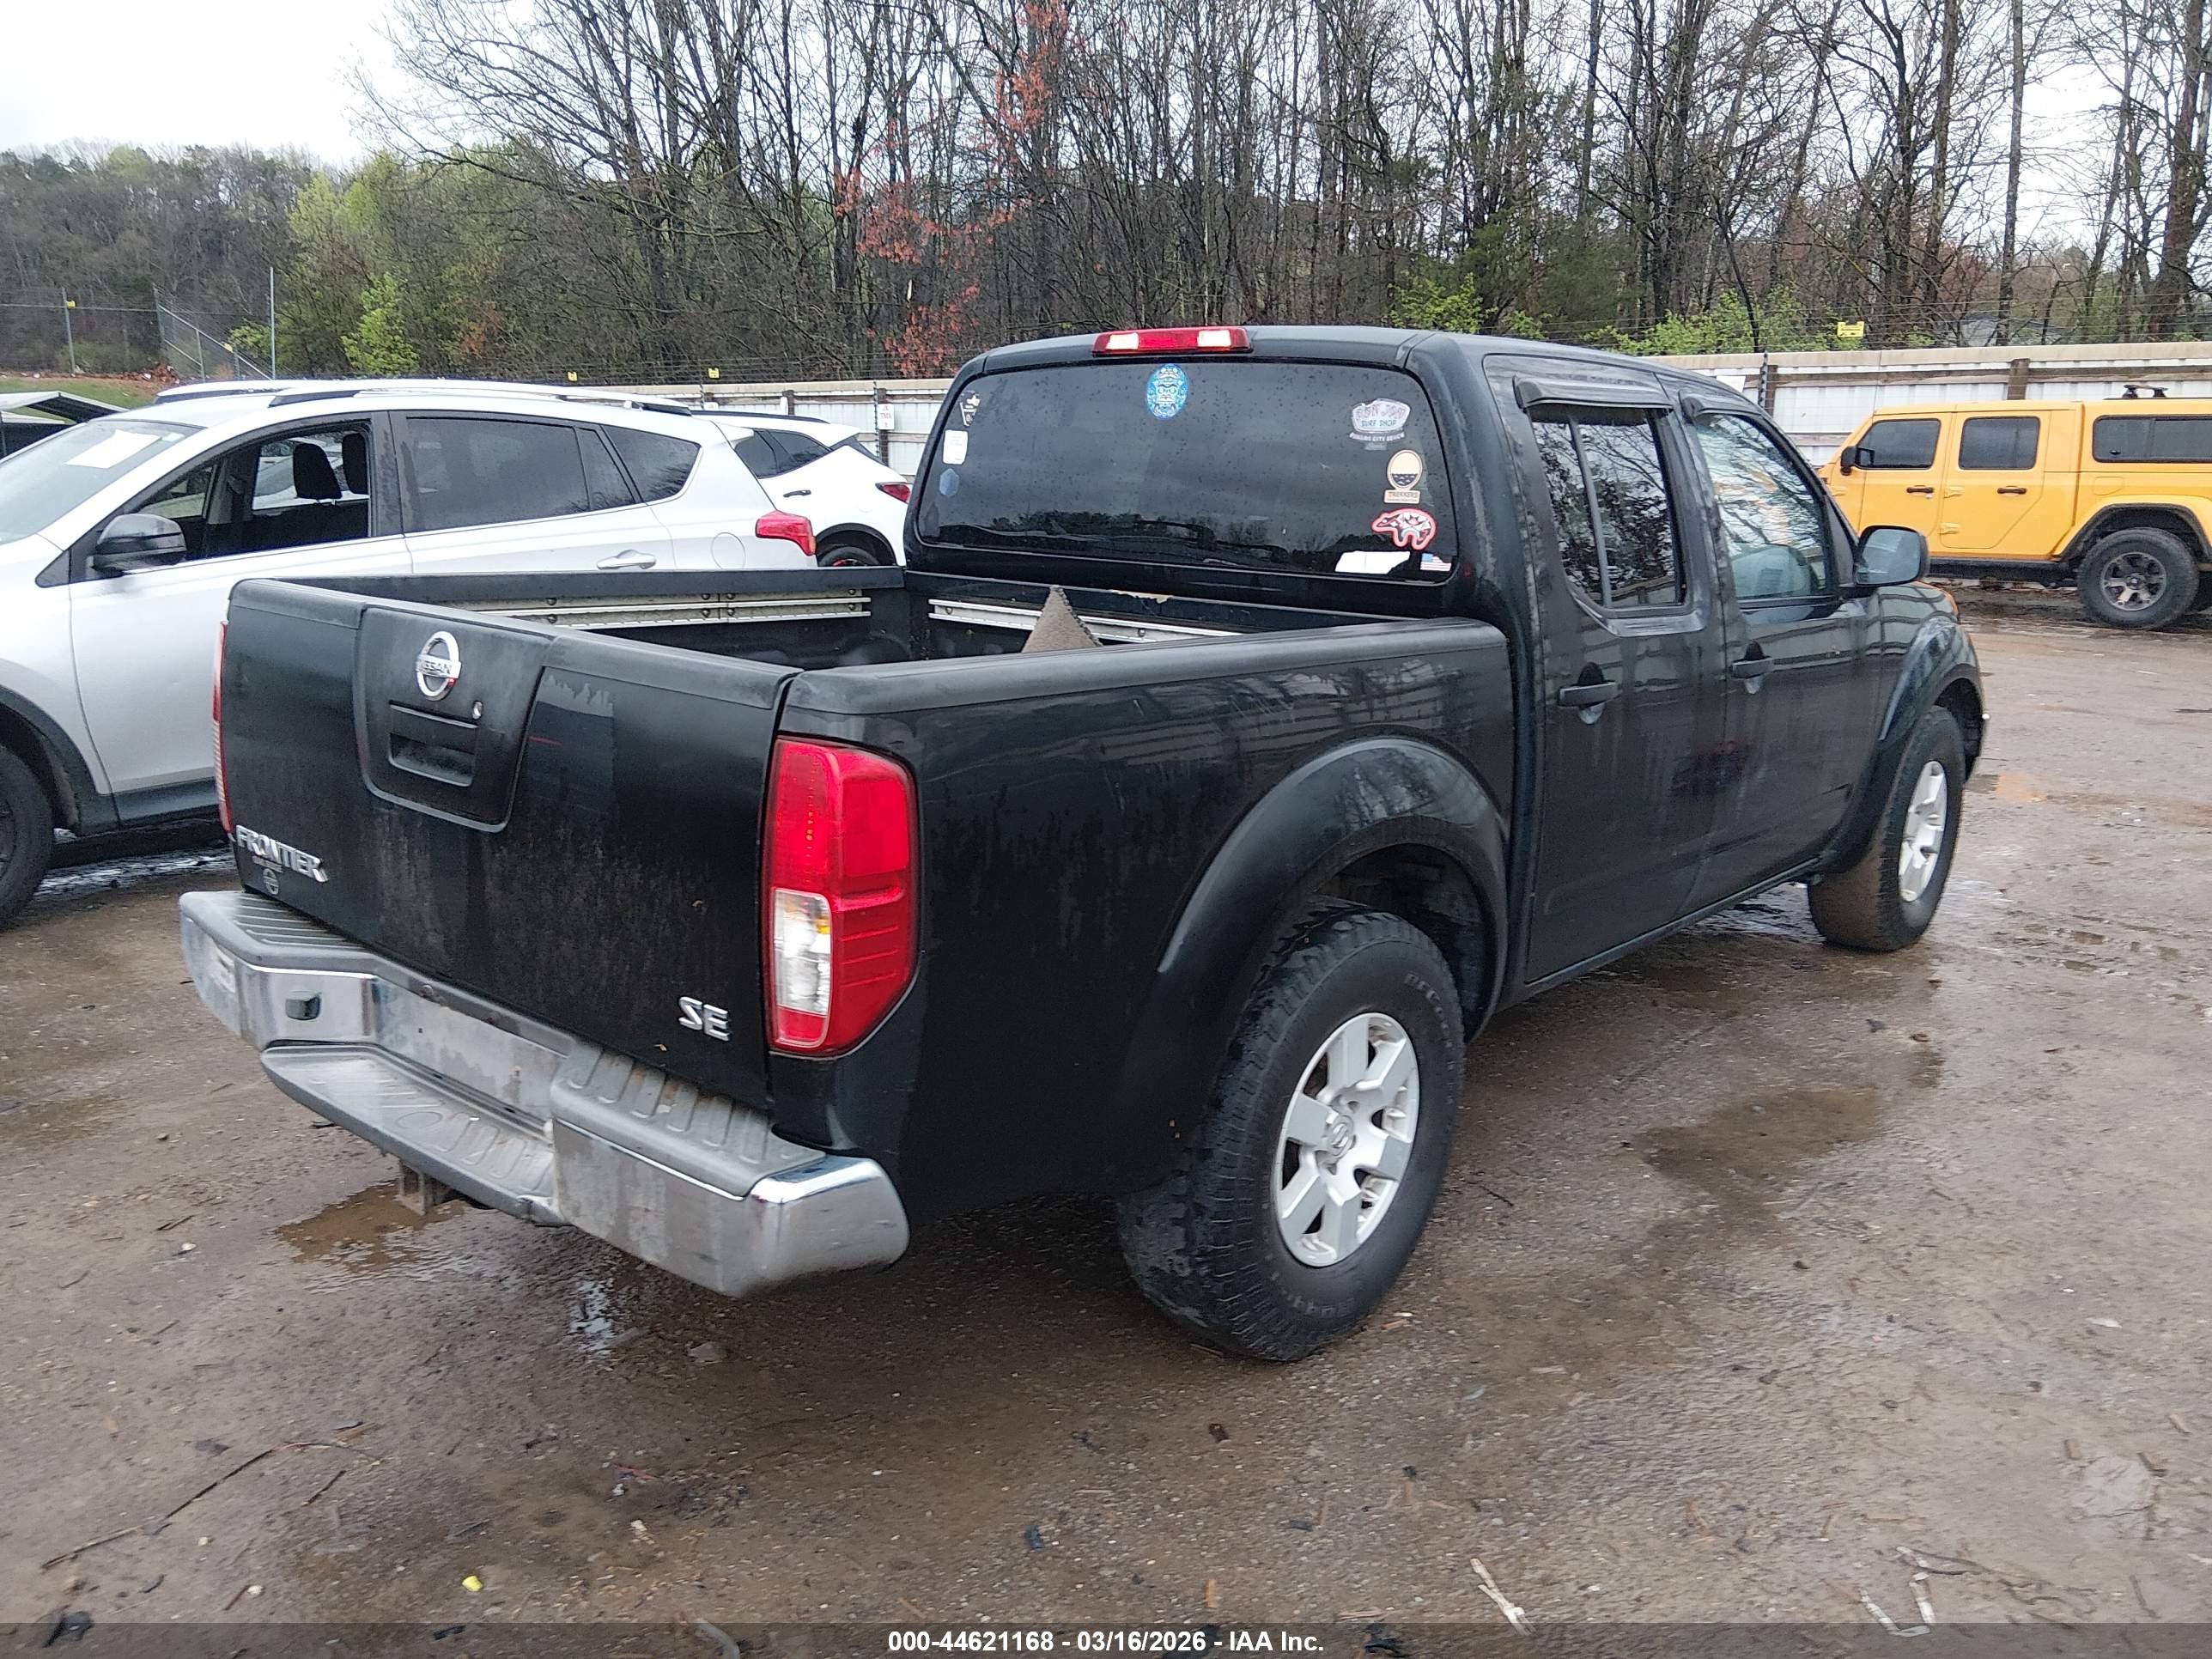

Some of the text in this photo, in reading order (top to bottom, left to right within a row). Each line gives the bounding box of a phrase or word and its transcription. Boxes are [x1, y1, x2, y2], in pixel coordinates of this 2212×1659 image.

[1361, 419, 1377, 428] SURF
[236, 824, 328, 883] FRONTIER
[678, 997, 730, 1042] SE
